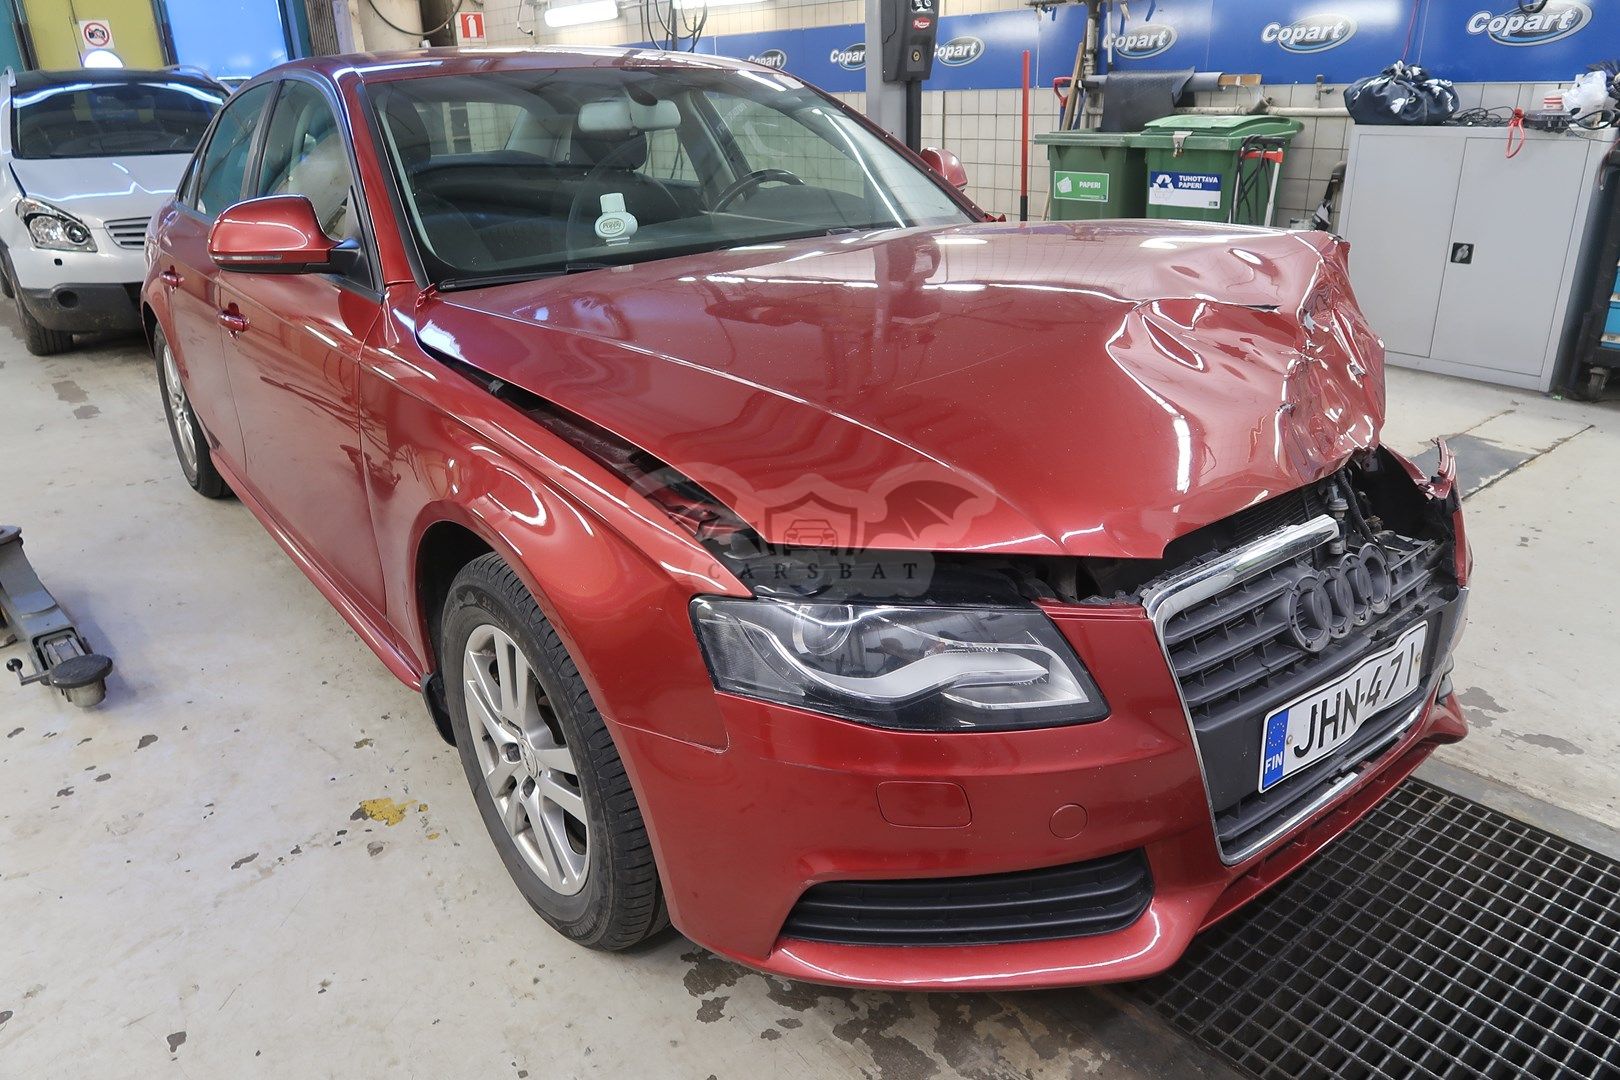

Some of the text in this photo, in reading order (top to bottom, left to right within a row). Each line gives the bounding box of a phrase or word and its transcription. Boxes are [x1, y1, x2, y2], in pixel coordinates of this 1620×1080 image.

[1262, 19, 1344, 44] Copart
[1467, 9, 1577, 37] Copart
[1103, 30, 1167, 51] Copart
[830, 49, 866, 65] Copar
[1079, 181, 1101, 189] PAPERI
[1293, 642, 1415, 758] JHN-471
[1264, 751, 1283, 775] FIN
